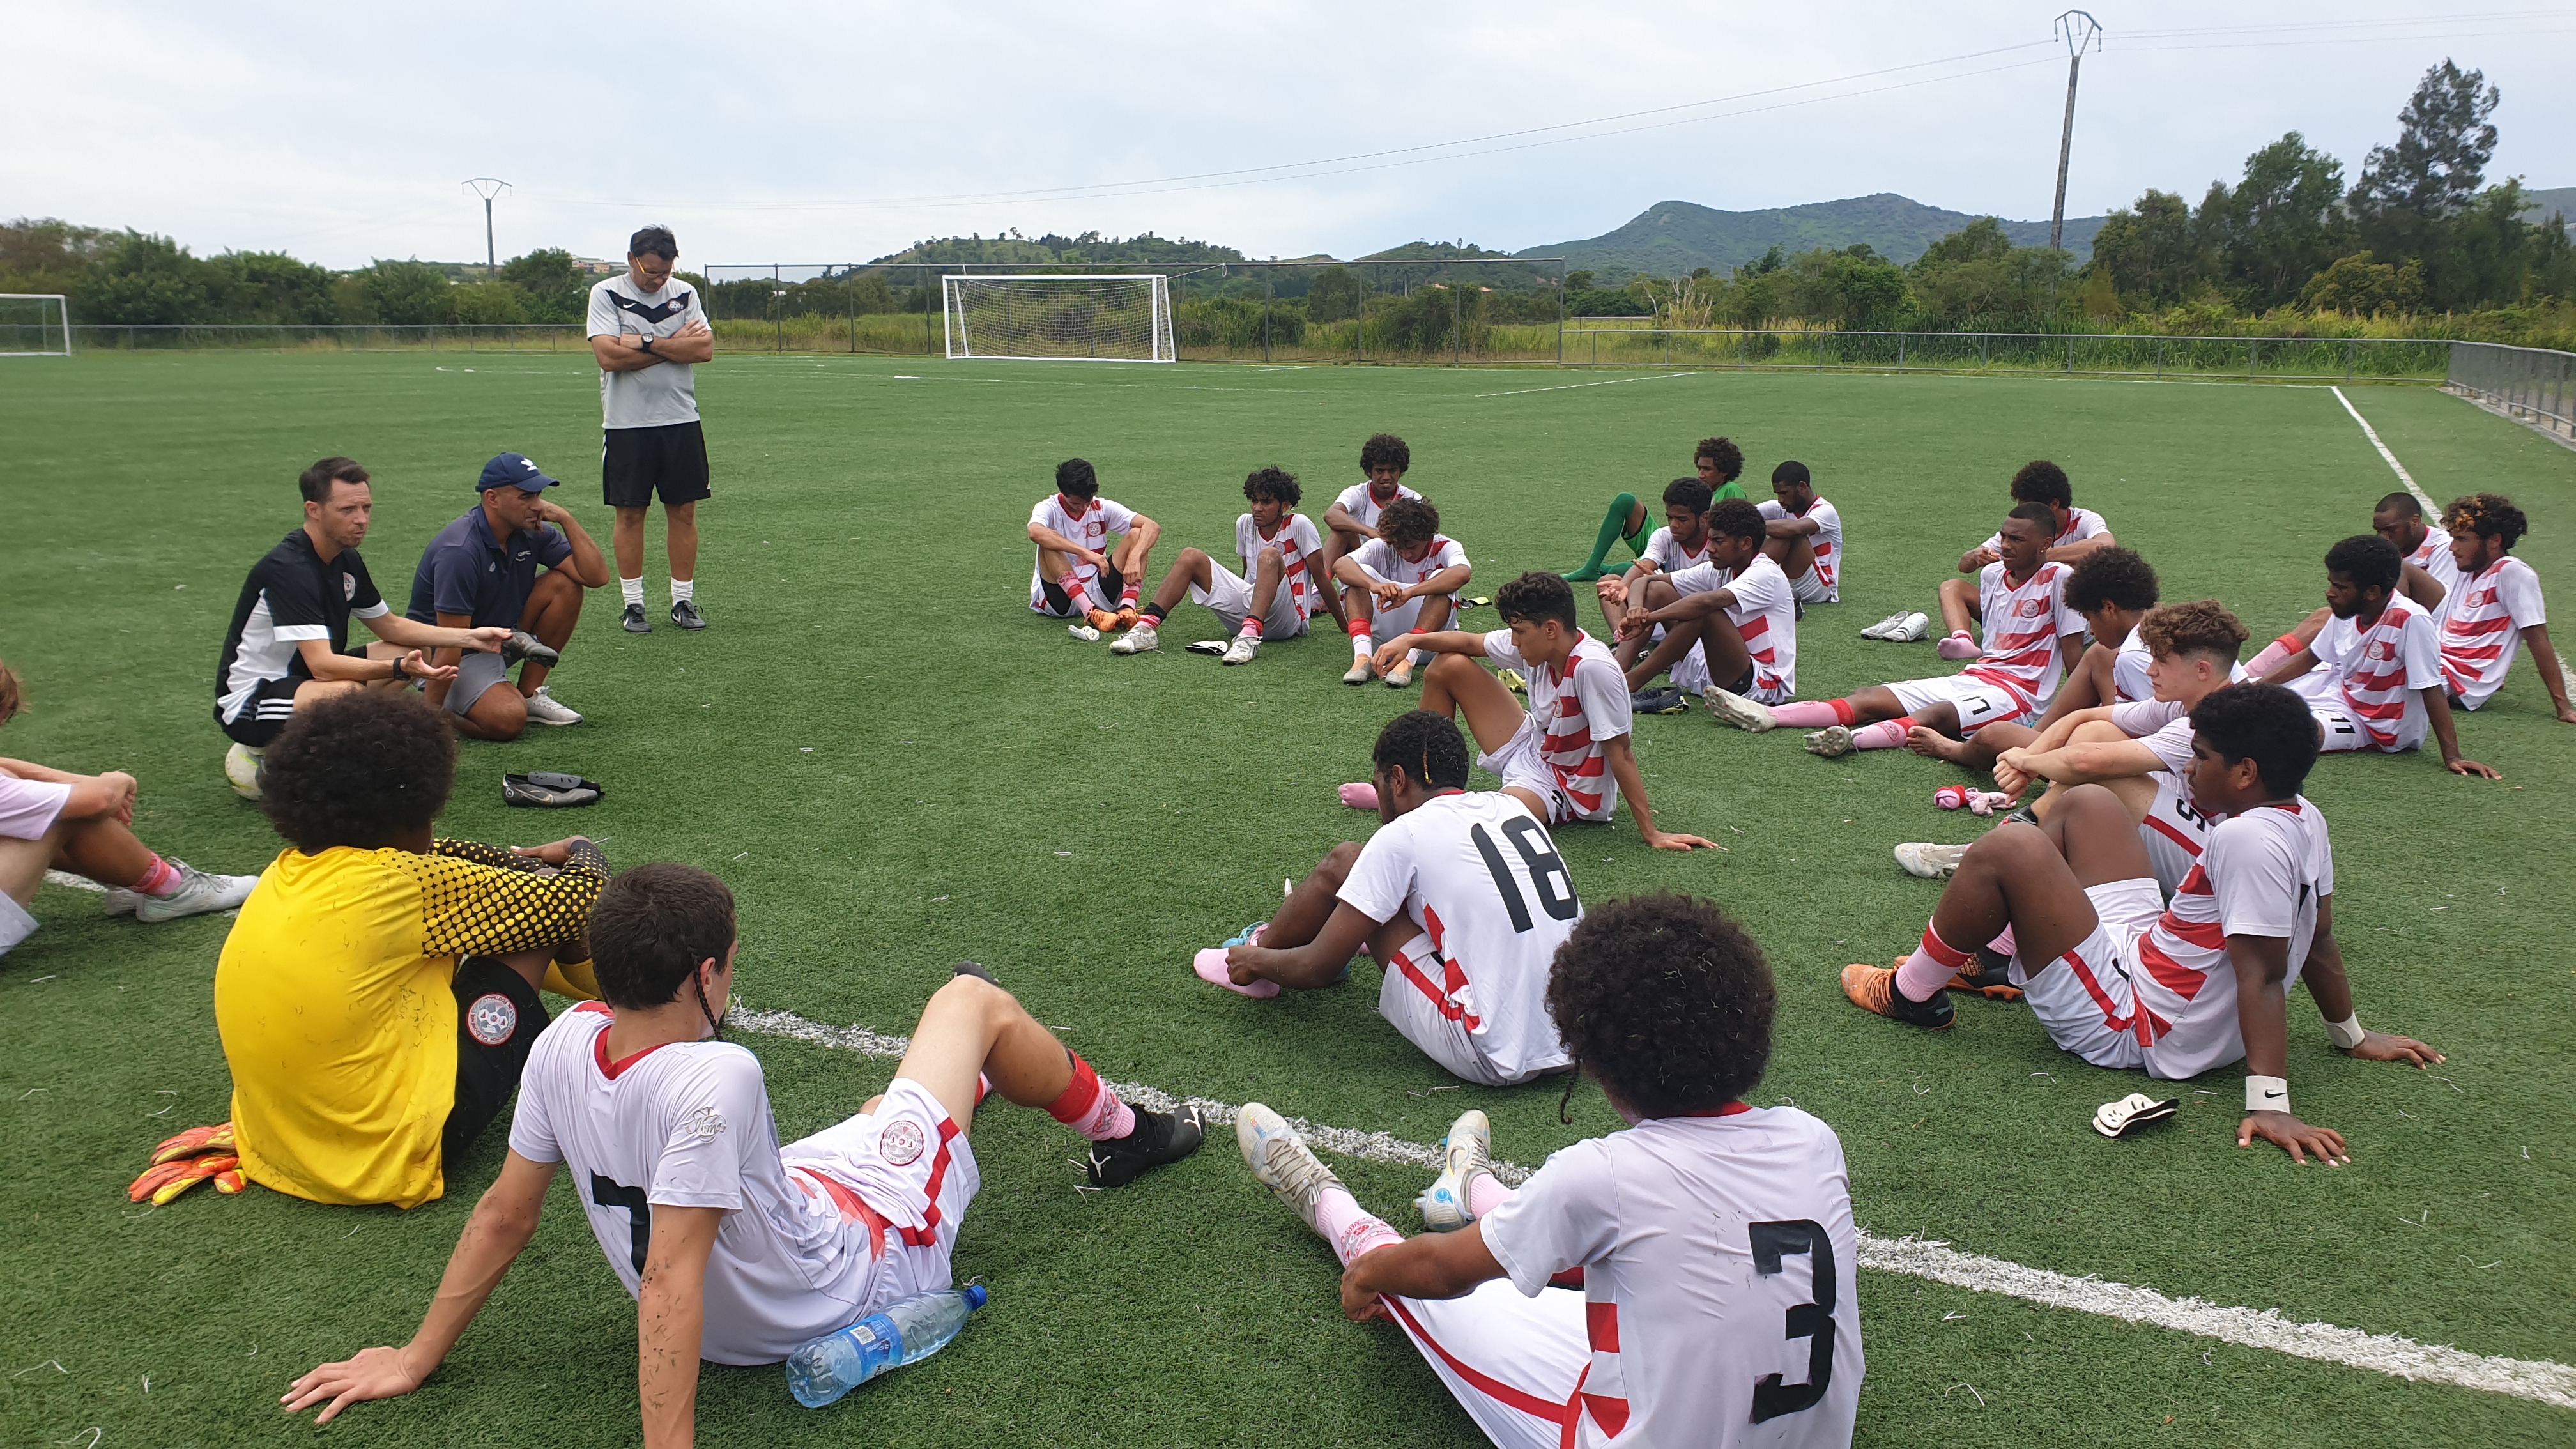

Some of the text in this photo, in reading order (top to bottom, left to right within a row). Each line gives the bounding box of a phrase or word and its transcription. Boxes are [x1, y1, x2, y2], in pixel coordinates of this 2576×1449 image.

[1962, 696, 1991, 716] 17
[2330, 716, 2356, 734] 11
[2175, 798, 2205, 833] 5
[1470, 815, 1579, 934] 18
[589, 1167, 651, 1278] 7
[1748, 1218, 1837, 1419] 3
